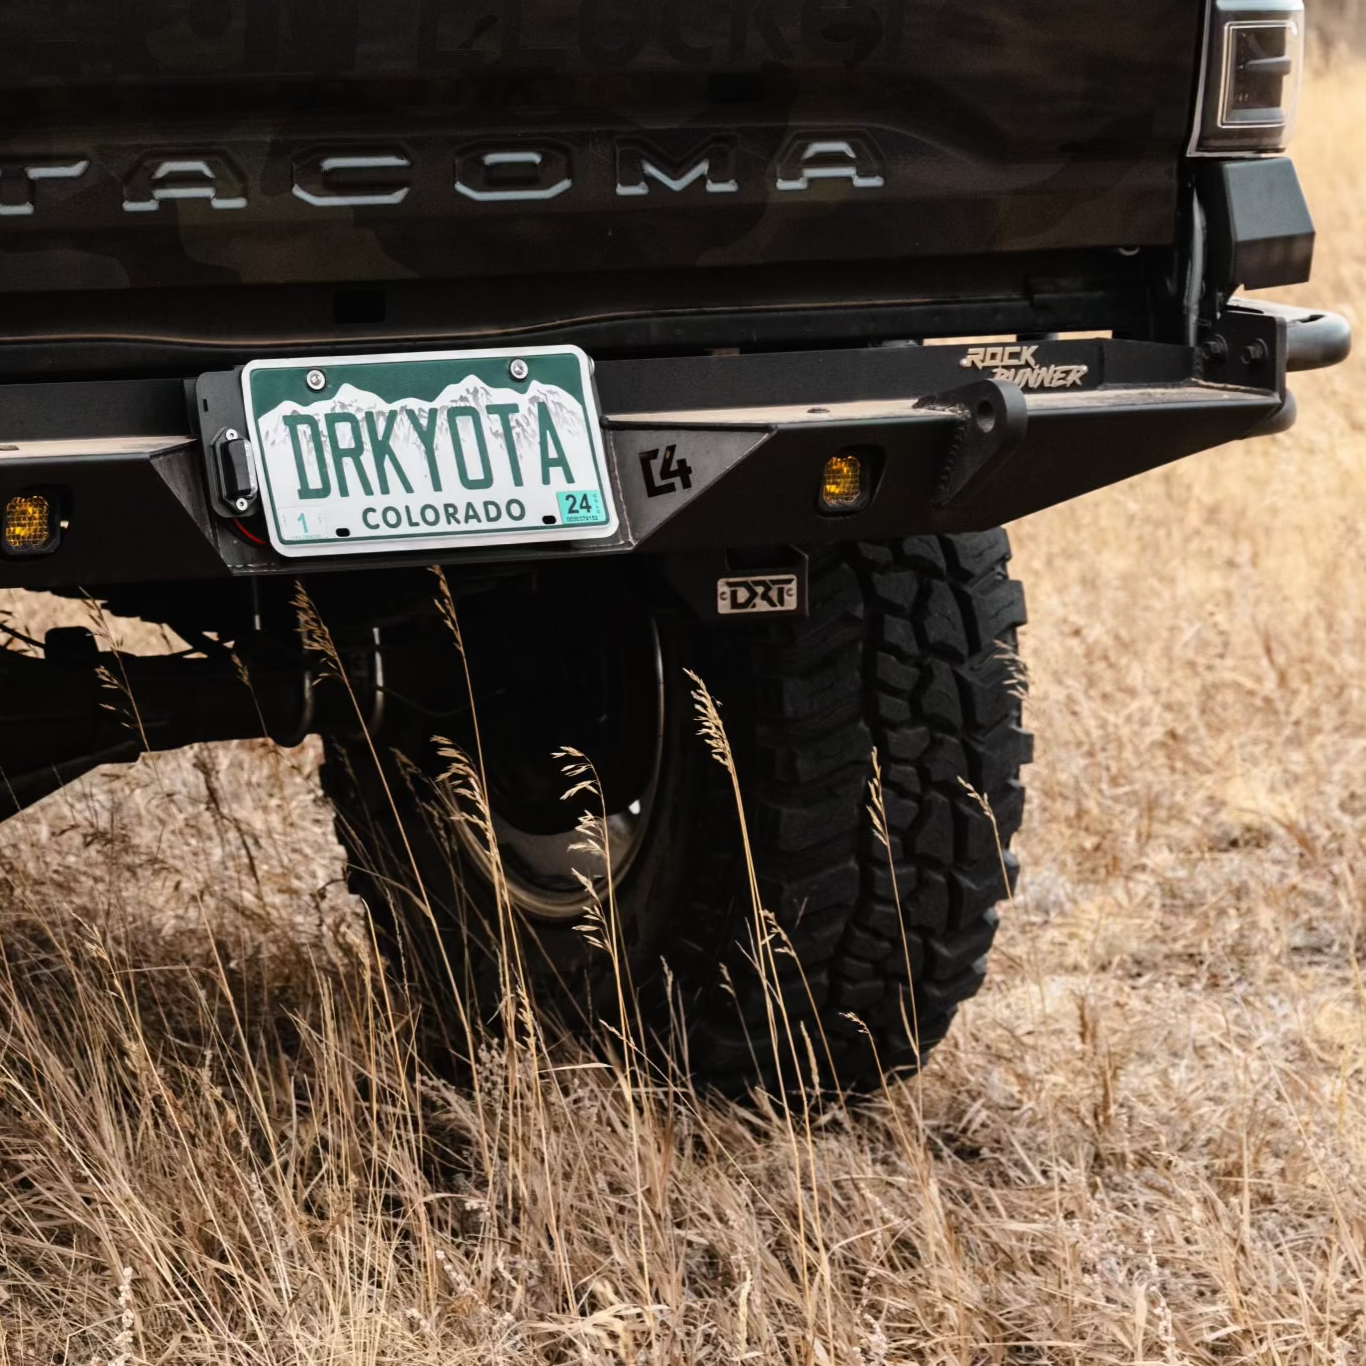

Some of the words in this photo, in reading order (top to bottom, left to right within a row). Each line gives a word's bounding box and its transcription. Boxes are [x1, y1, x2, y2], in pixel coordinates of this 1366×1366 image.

[966, 345, 1039, 368] ROCK
[282, 401, 576, 500] DRKYOTA
[362, 498, 527, 531] COLORADO
[565, 493, 592, 514] 24
[298, 512, 309, 533] 1
[725, 578, 795, 610] DRT
